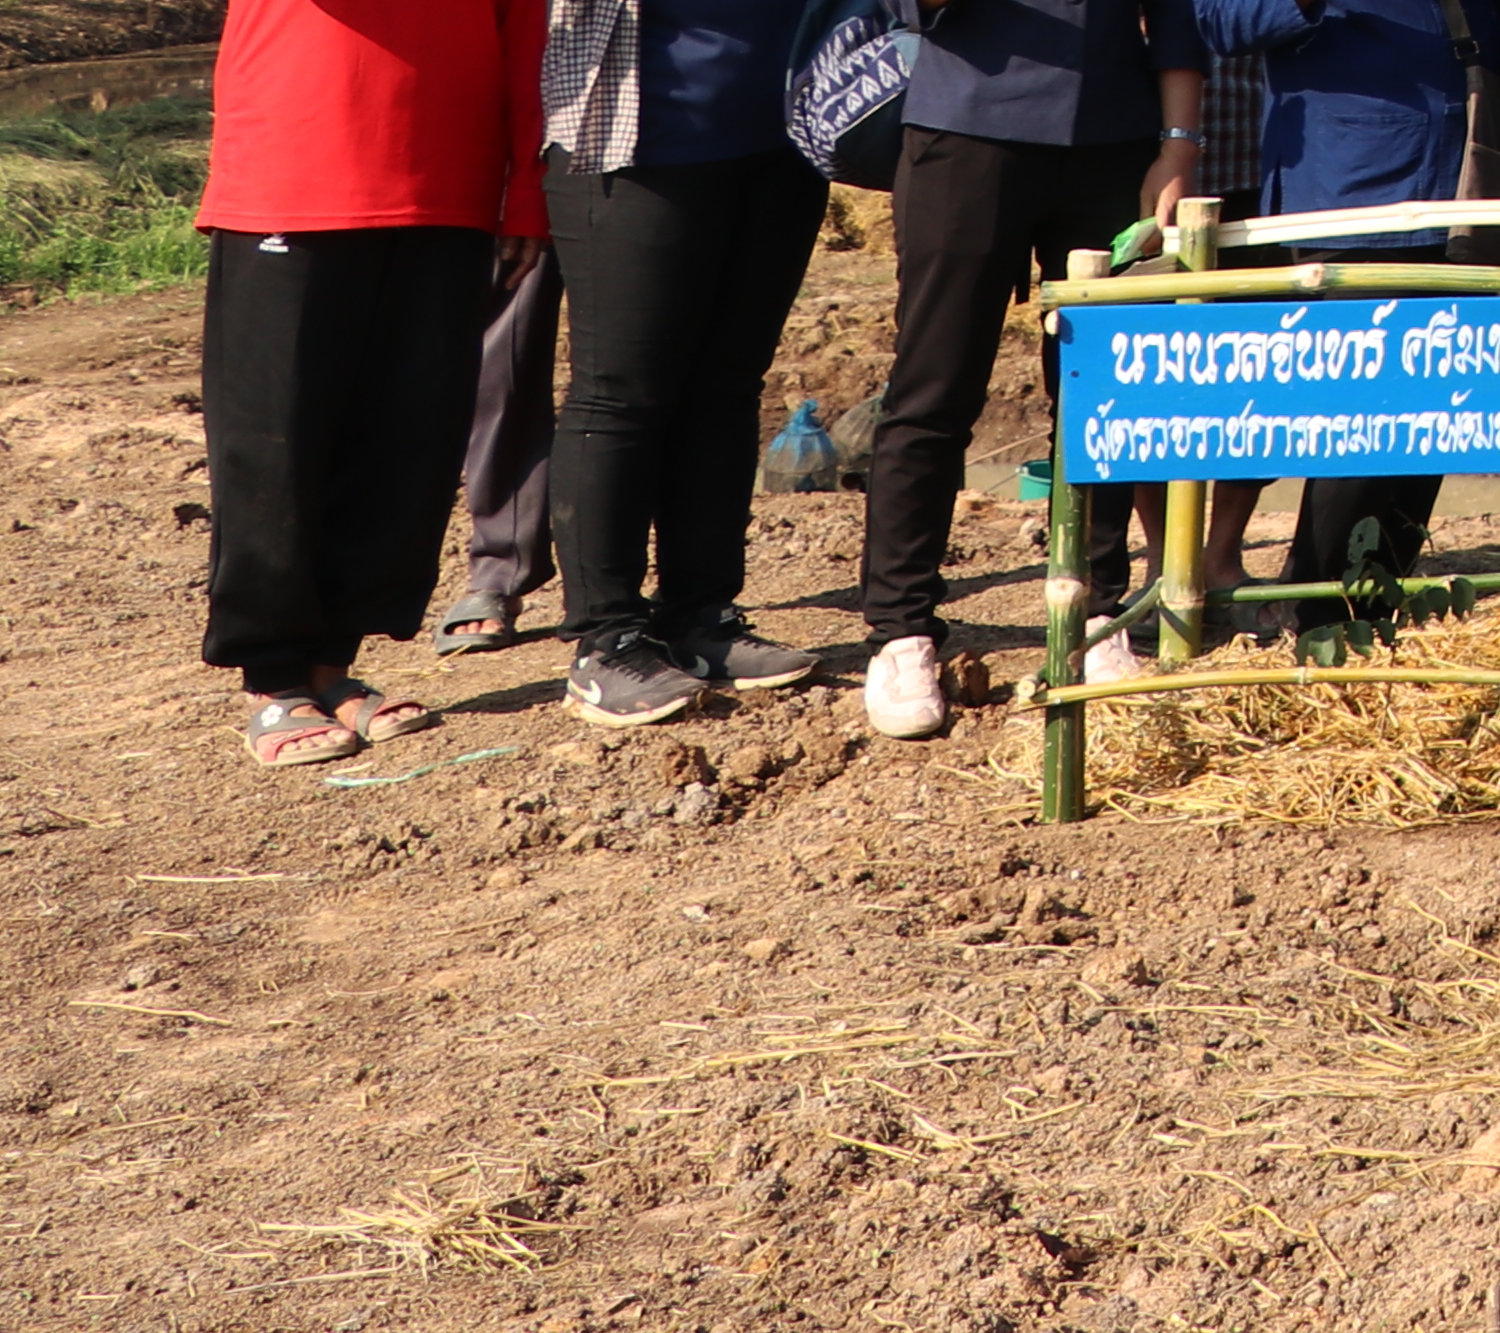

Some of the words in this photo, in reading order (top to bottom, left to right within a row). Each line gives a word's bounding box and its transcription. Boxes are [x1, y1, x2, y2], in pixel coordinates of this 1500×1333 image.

[1110, 299, 1398, 385] นางนวลจันทร์
